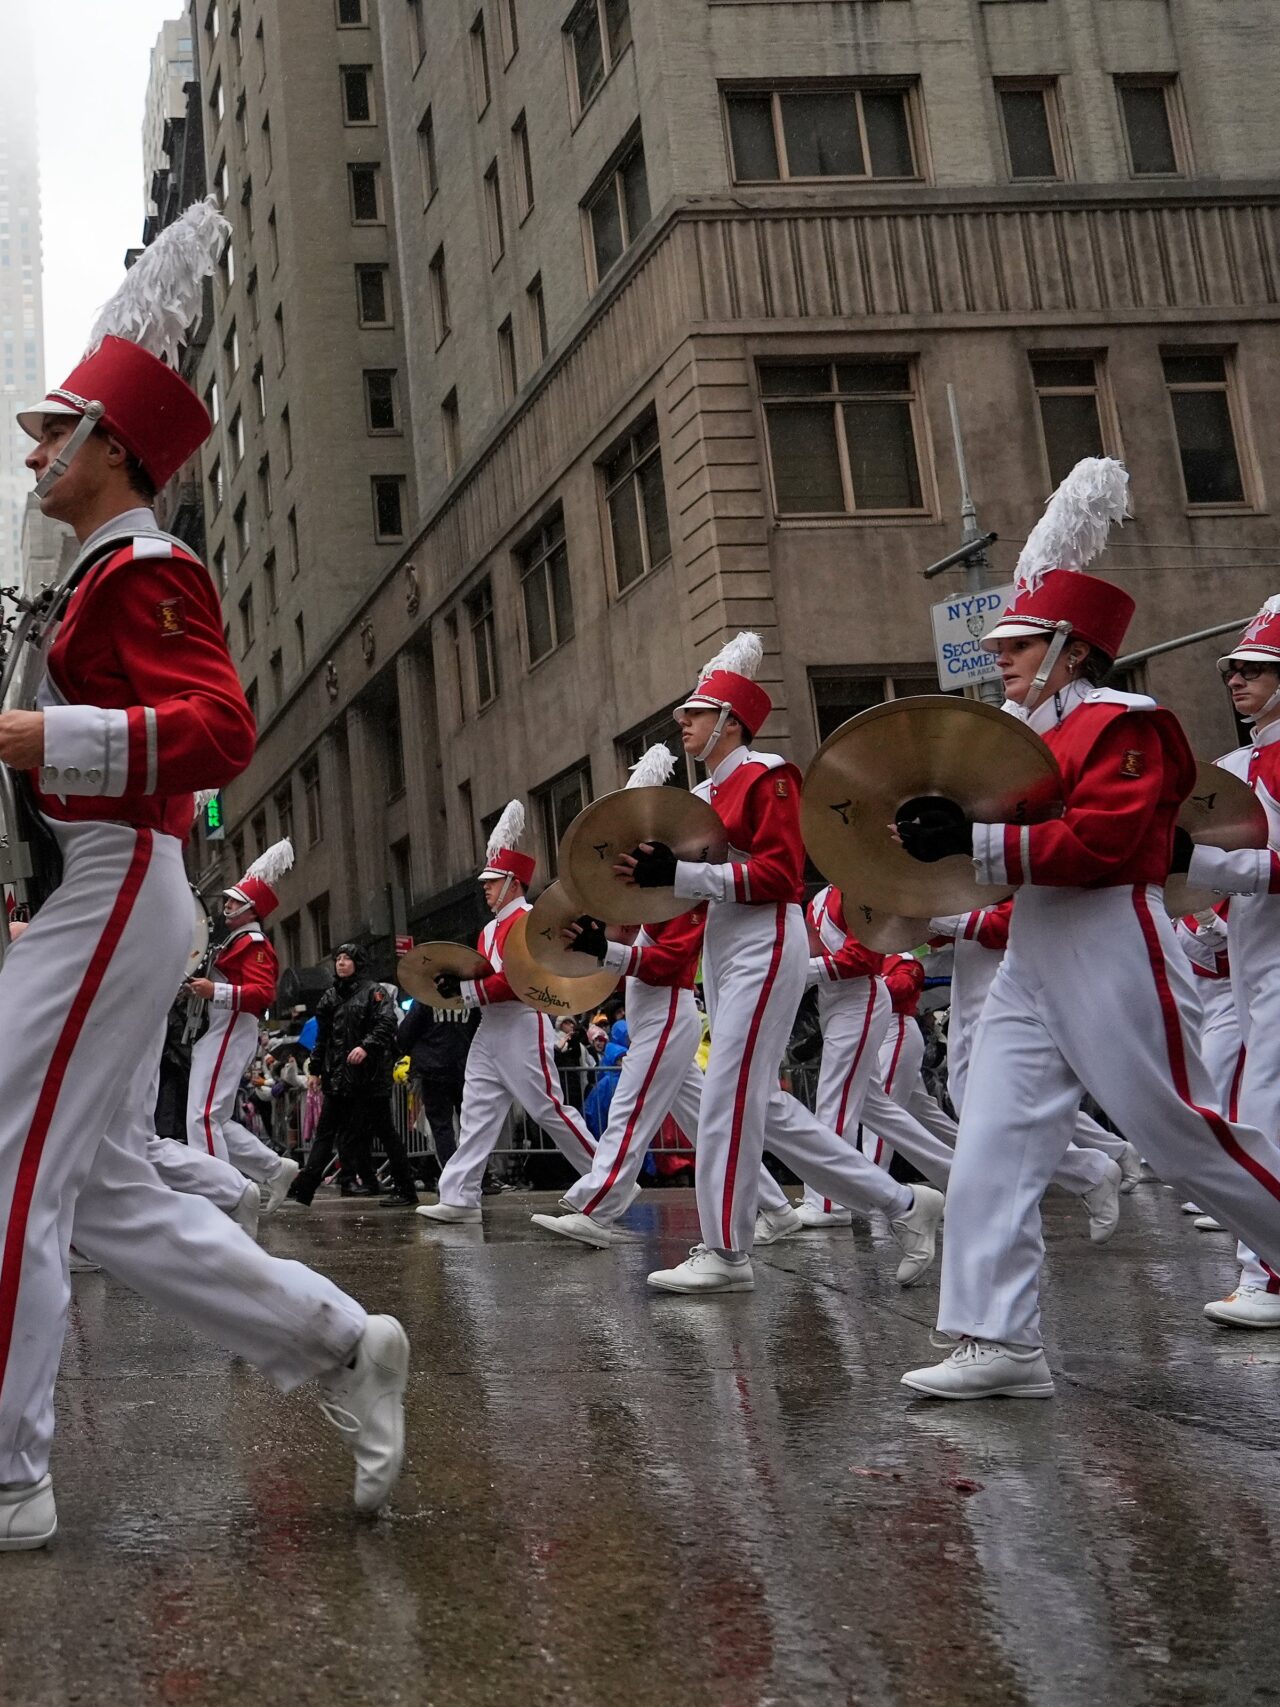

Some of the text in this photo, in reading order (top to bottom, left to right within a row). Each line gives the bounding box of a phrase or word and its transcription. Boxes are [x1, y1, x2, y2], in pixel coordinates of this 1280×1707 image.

[947, 594, 1002, 621] NYPD
[942, 640, 981, 660] SECU
[967, 666, 996, 678] IN AREA
[524, 986, 571, 1009] Zildjian
